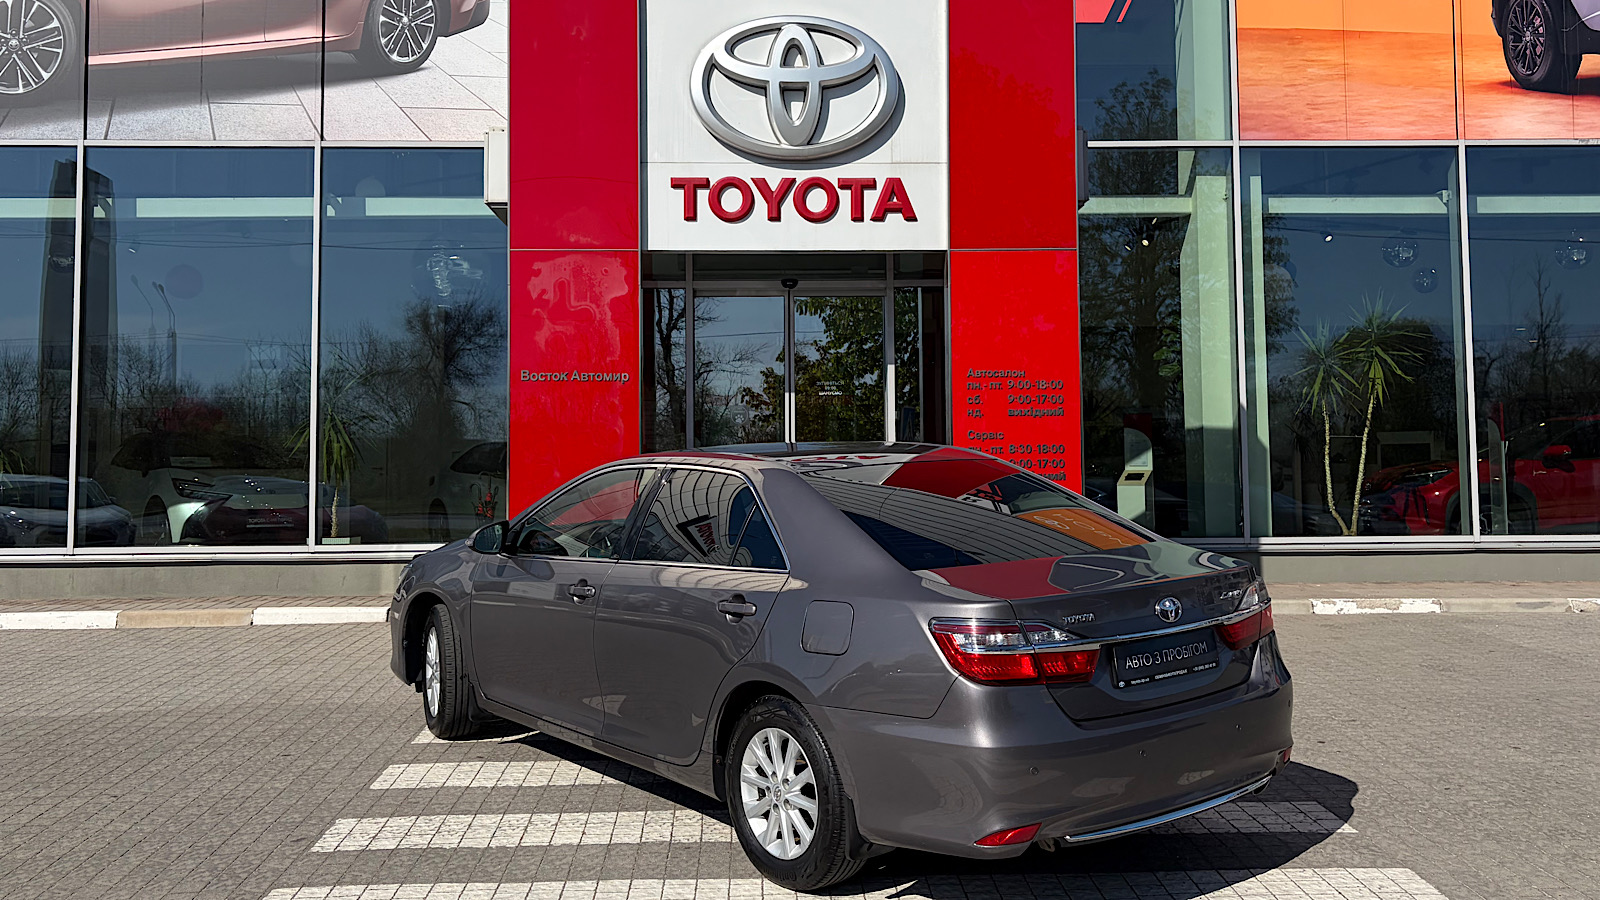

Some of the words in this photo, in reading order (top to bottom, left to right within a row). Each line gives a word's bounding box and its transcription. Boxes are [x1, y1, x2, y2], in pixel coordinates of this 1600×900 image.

[670, 175, 919, 224] TOYOTA
[520, 370, 568, 382] Восток
[571, 370, 630, 384] Автомир
[967, 368, 1026, 378] Автосалон
[967, 395, 984, 404] сб.
[1008, 394, 1065, 404] 9:00-17:00
[967, 409, 985, 418] нд.
[1008, 406, 1065, 418] вихідний
[967, 430, 1005, 441] Сервіс
[1062, 613, 1096, 624] TOYOTA
[1126, 652, 1153, 670] АВТО
[1162, 641, 1208, 662] ПРОБІГОМ
